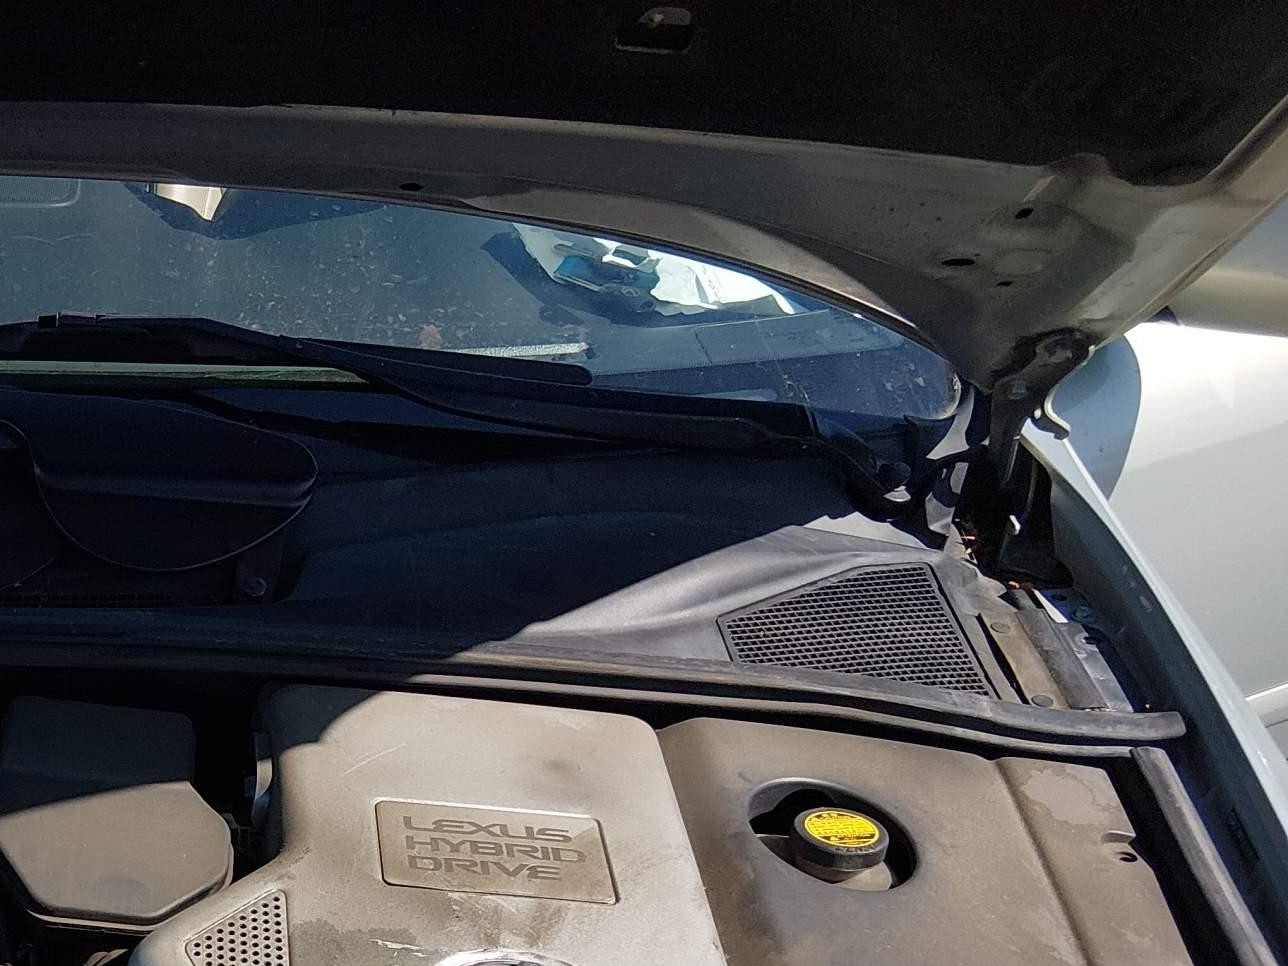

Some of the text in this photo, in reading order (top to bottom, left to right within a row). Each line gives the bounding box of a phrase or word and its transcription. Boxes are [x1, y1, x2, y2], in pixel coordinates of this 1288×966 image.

[402, 815, 573, 843] LEXUS
[405, 834, 588, 863] HYBRID
[407, 855, 563, 881] DRIVE
